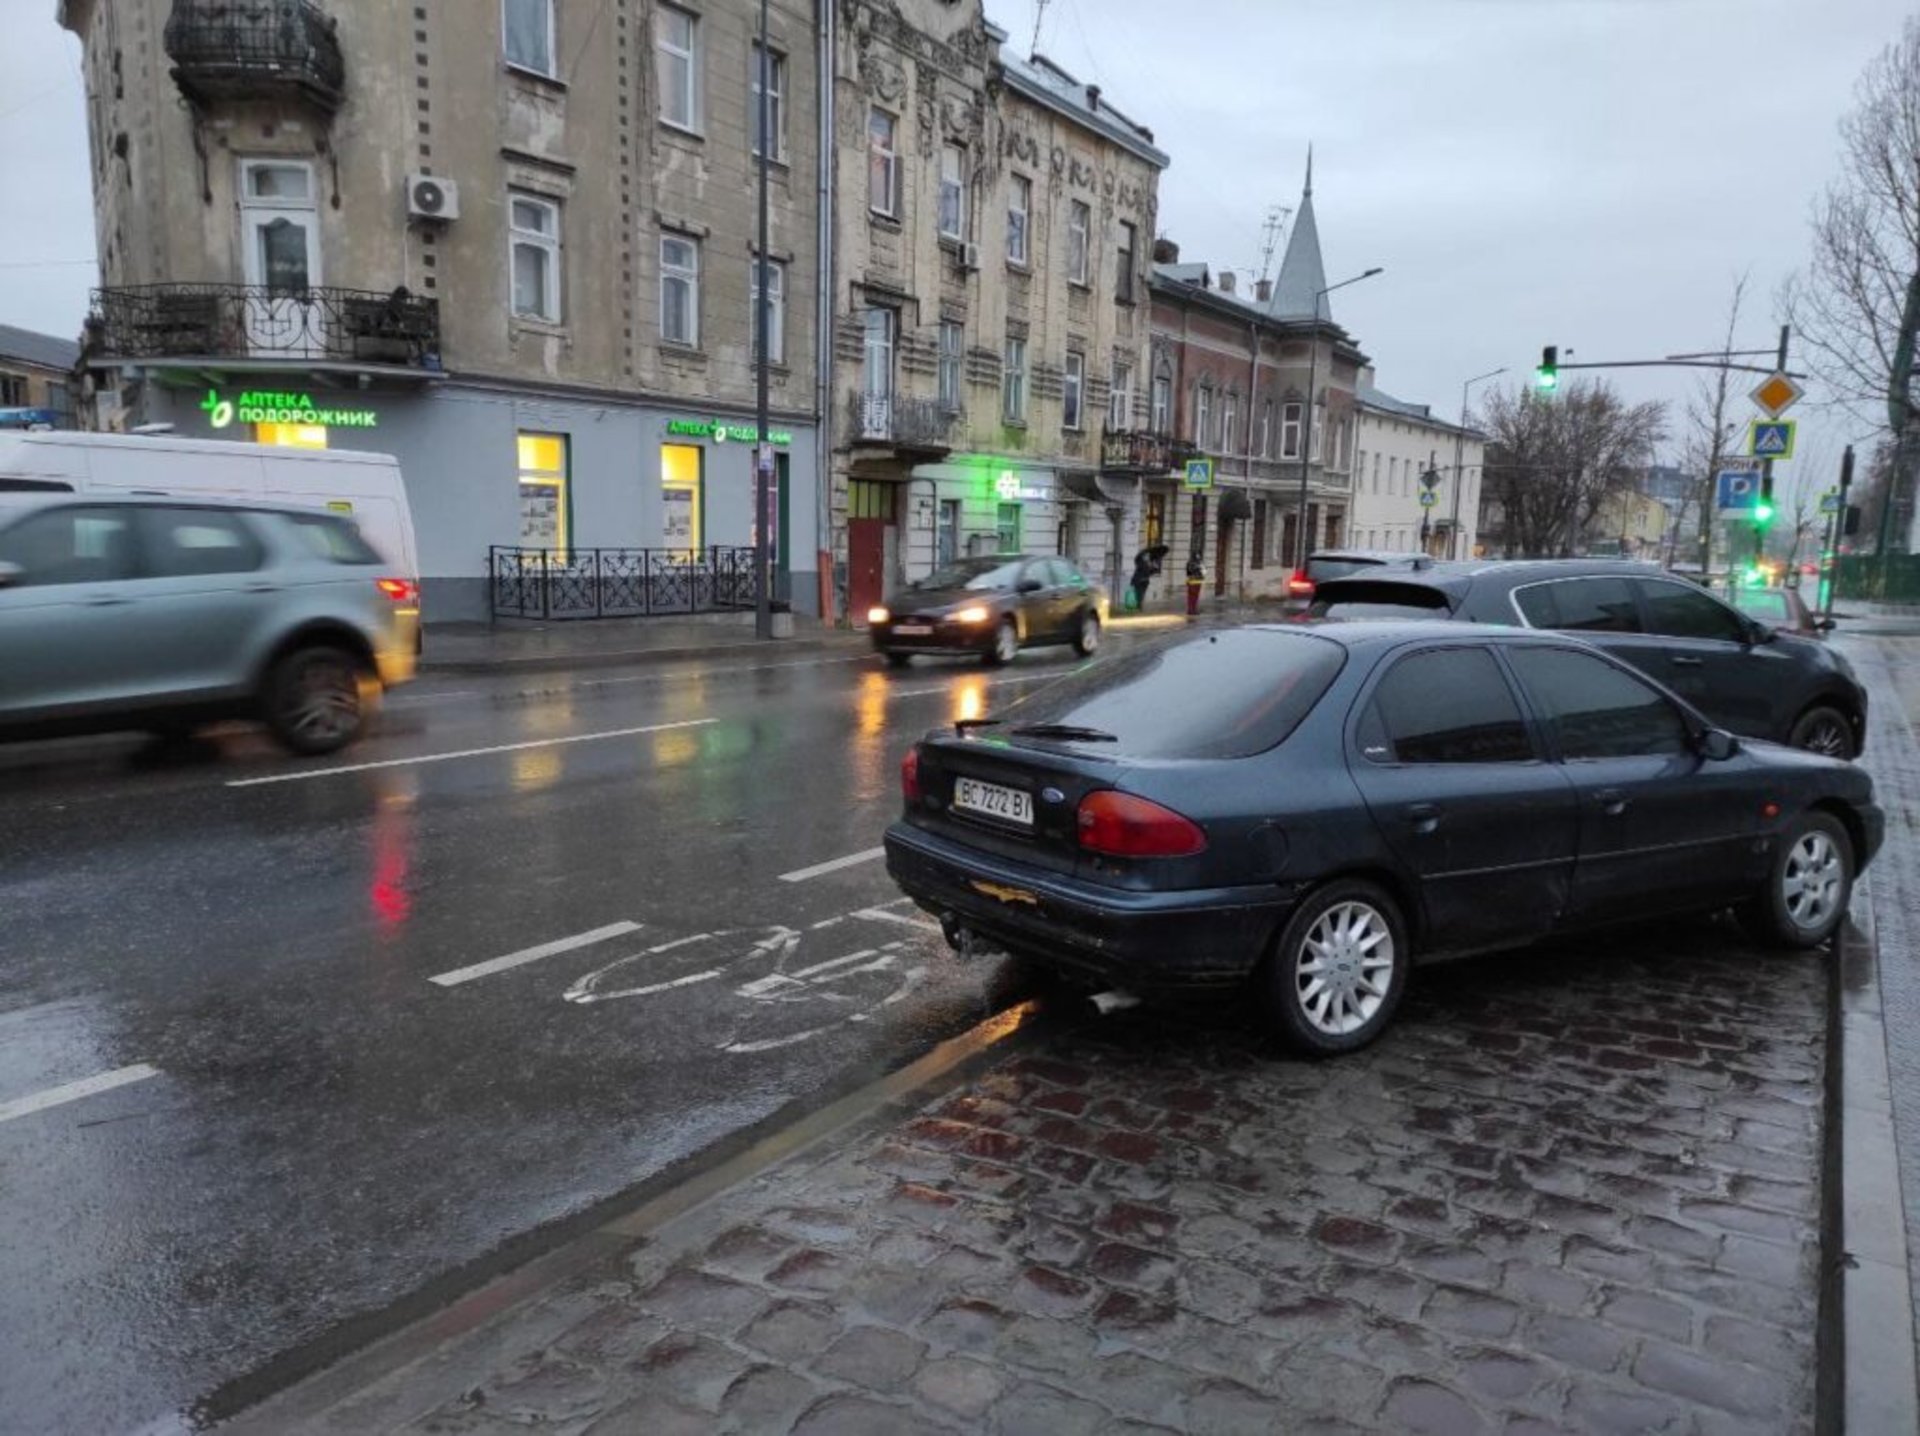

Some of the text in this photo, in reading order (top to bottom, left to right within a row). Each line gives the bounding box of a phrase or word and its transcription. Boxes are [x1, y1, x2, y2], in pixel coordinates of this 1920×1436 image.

[239, 391, 312, 408] АПТЕКА
[239, 408, 377, 427] ПОДОРОЖНИК
[962, 781, 979, 806] BC
[982, 785, 1009, 814] 7272
